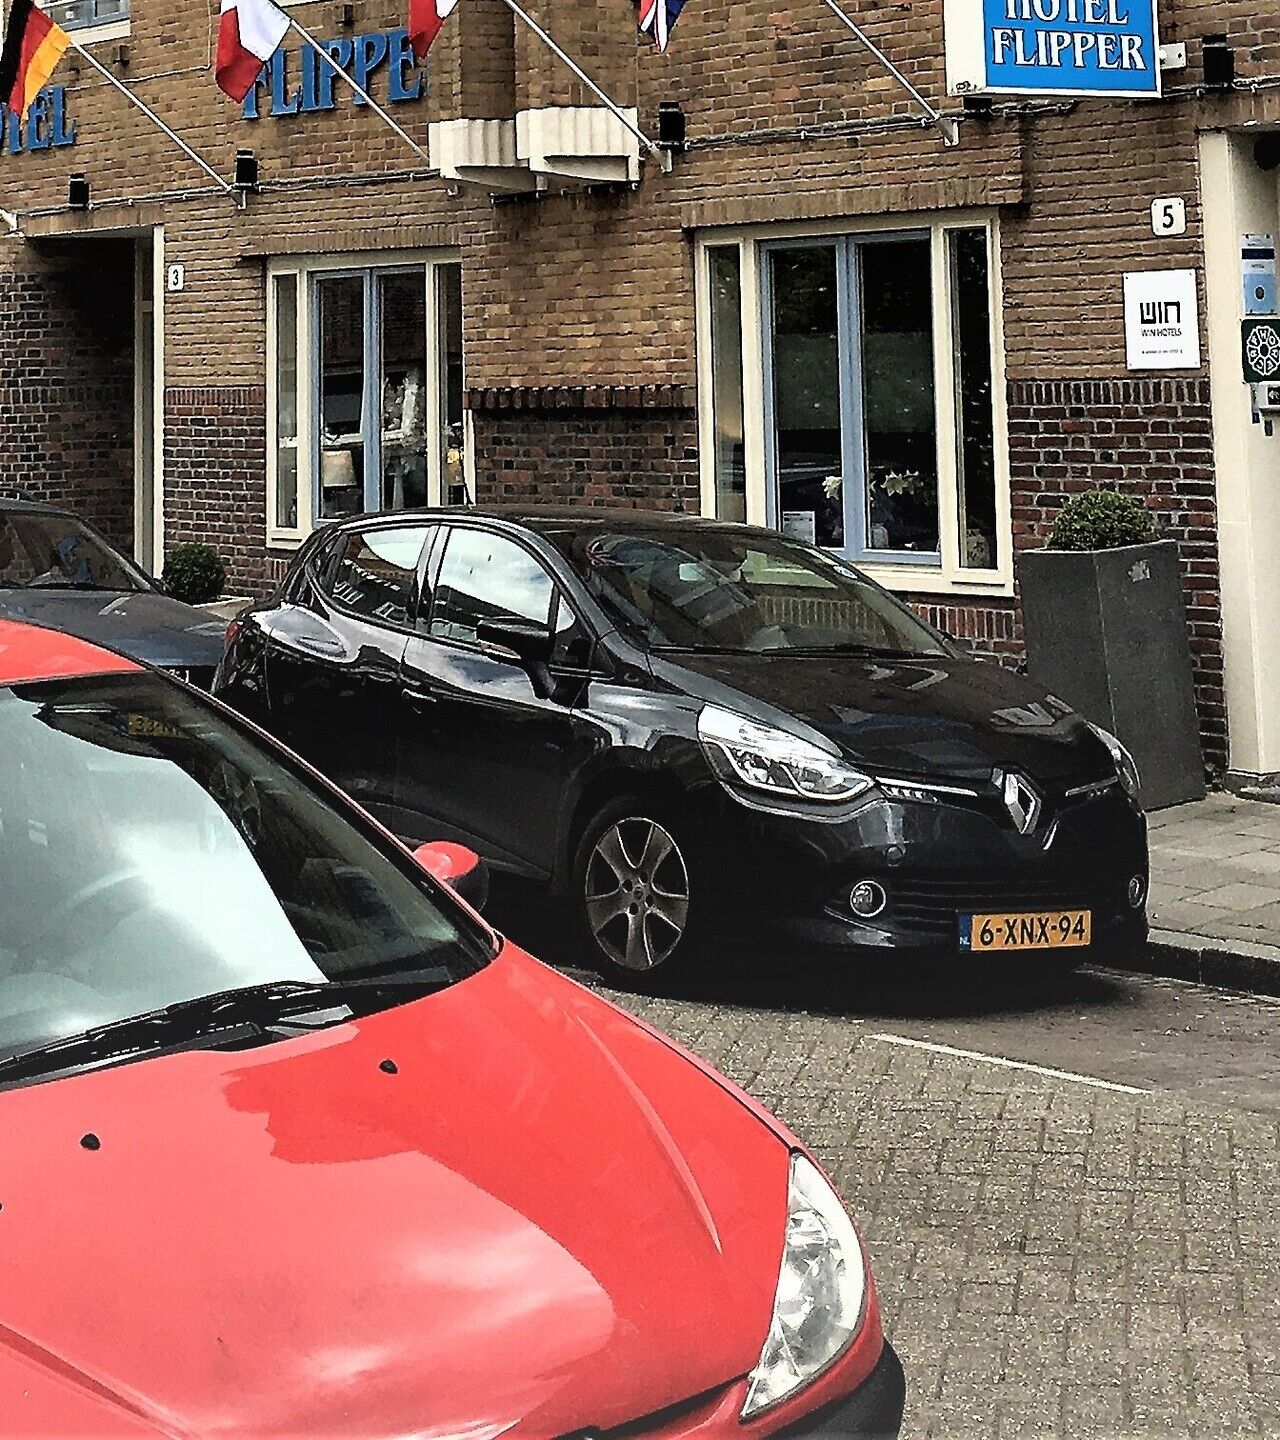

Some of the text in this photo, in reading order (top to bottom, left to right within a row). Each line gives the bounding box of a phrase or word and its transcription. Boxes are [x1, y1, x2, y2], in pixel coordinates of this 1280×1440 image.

[992, 27, 1148, 70] FLIPPER
[242, 28, 431, 119] FLIPPE
[1162, 204, 1174, 229] 5
[172, 269, 179, 287] 3
[979, 914, 1086, 947] 6-XNX-94
